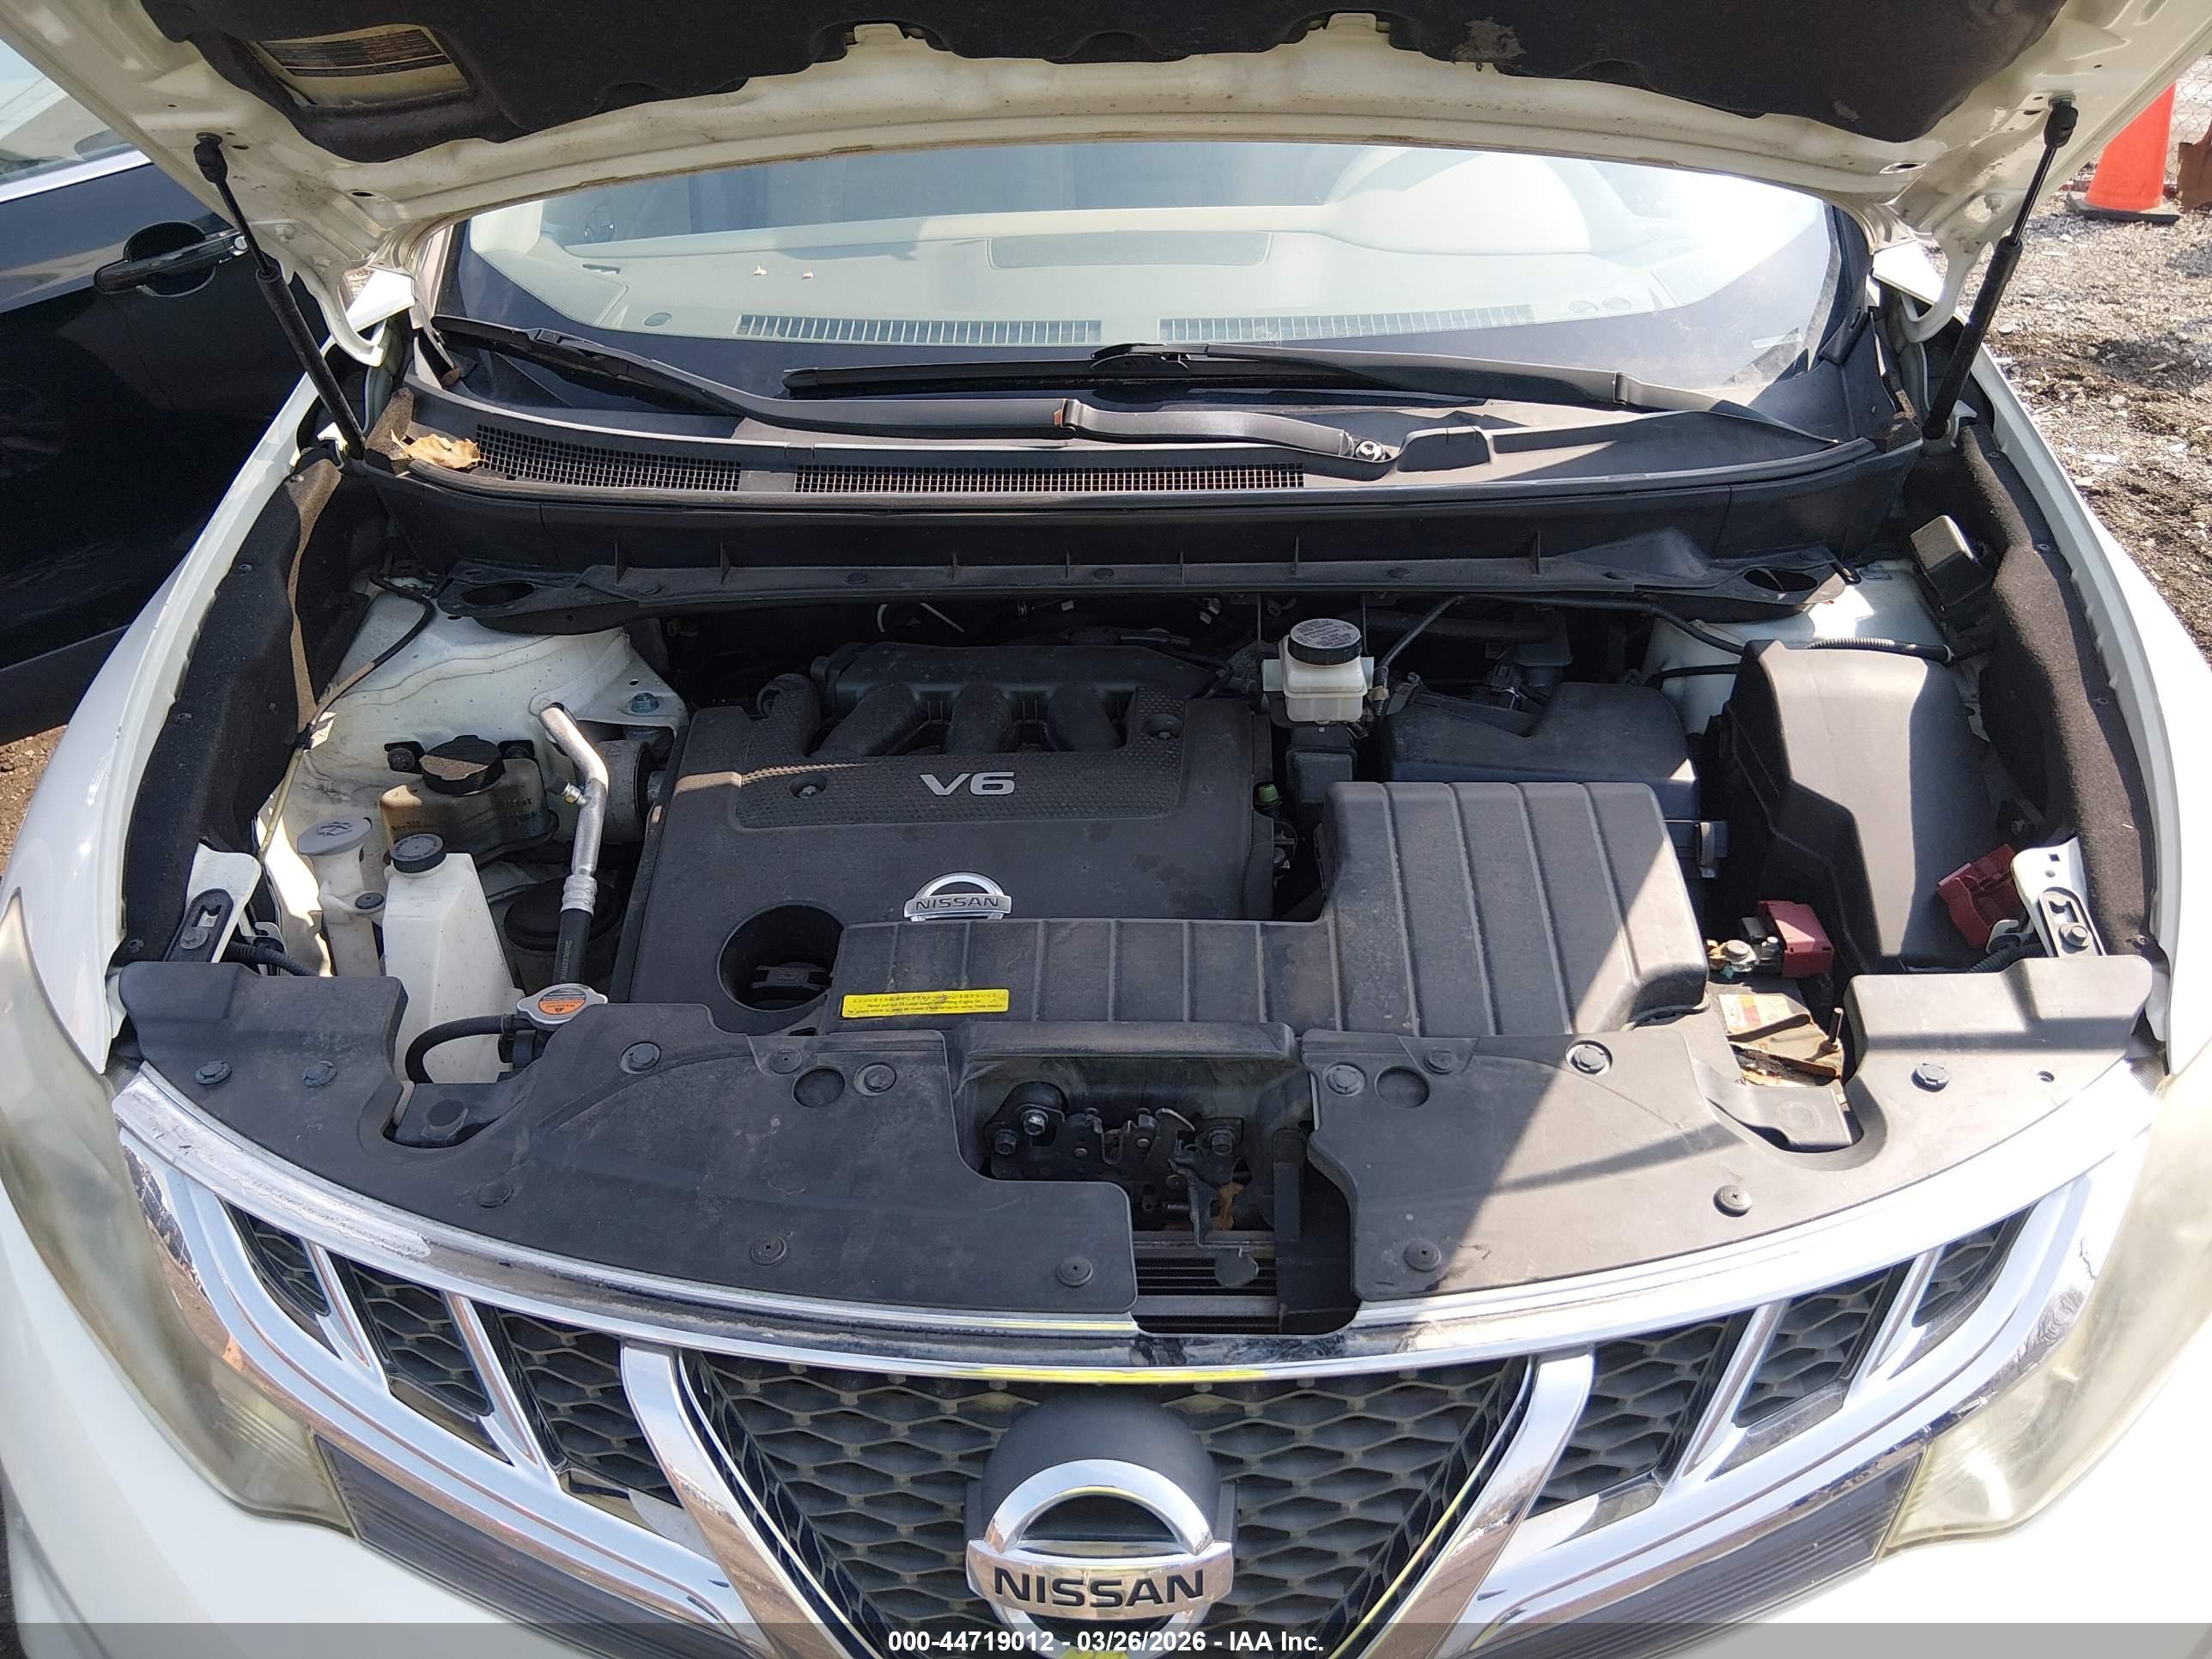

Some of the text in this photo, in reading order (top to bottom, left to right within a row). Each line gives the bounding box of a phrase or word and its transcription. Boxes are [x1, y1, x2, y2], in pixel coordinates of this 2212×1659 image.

[920, 771, 1015, 796] V6
[915, 896, 999, 911] NISSAN
[994, 1565, 1204, 1607] NISSAN
